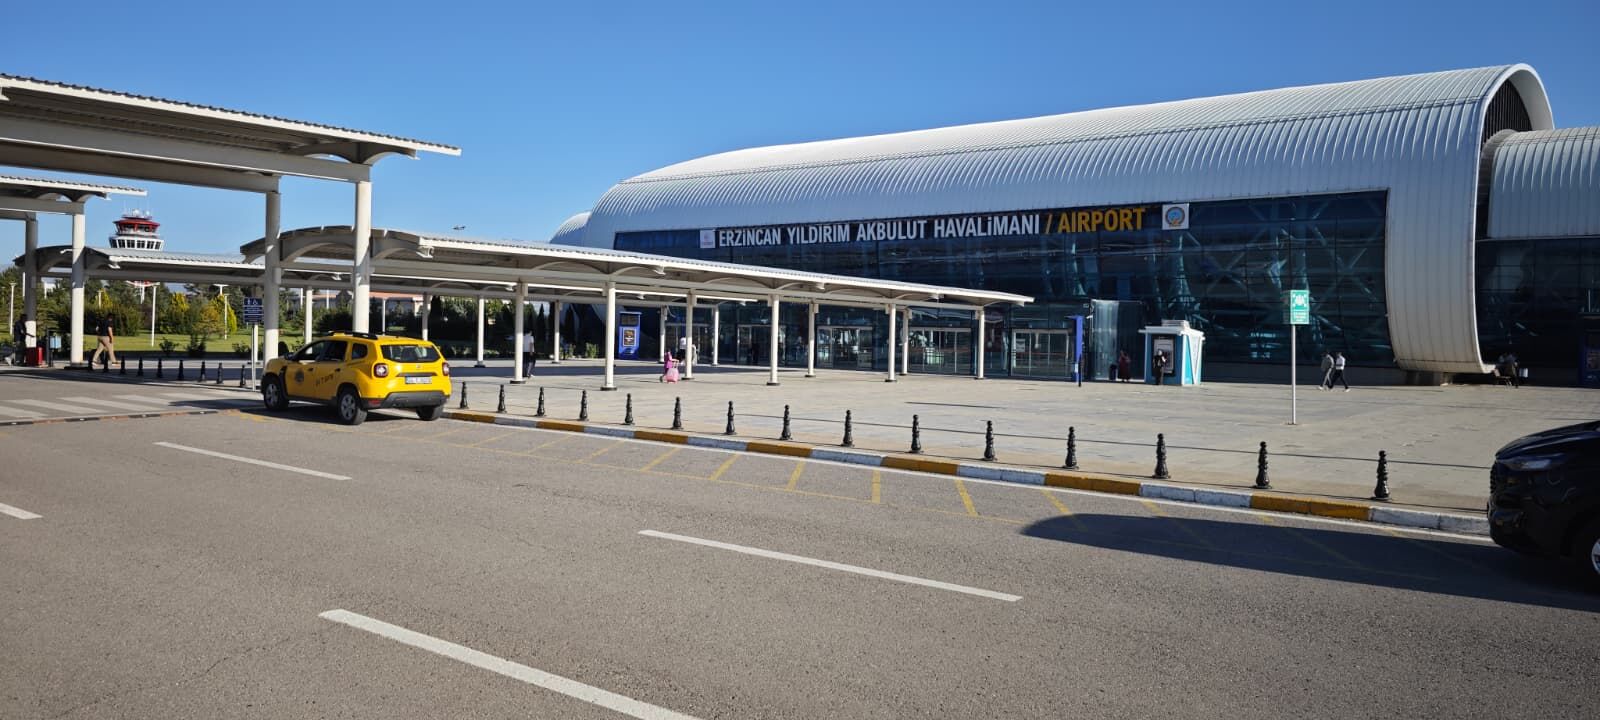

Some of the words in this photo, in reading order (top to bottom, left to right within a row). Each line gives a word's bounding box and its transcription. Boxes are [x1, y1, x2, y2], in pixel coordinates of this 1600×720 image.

[787, 223, 851, 245] YILDIRIM
[856, 219, 928, 242] AKBULUT
[1045, 214, 1052, 234] /
[1057, 208, 1146, 233] AIRPORT
